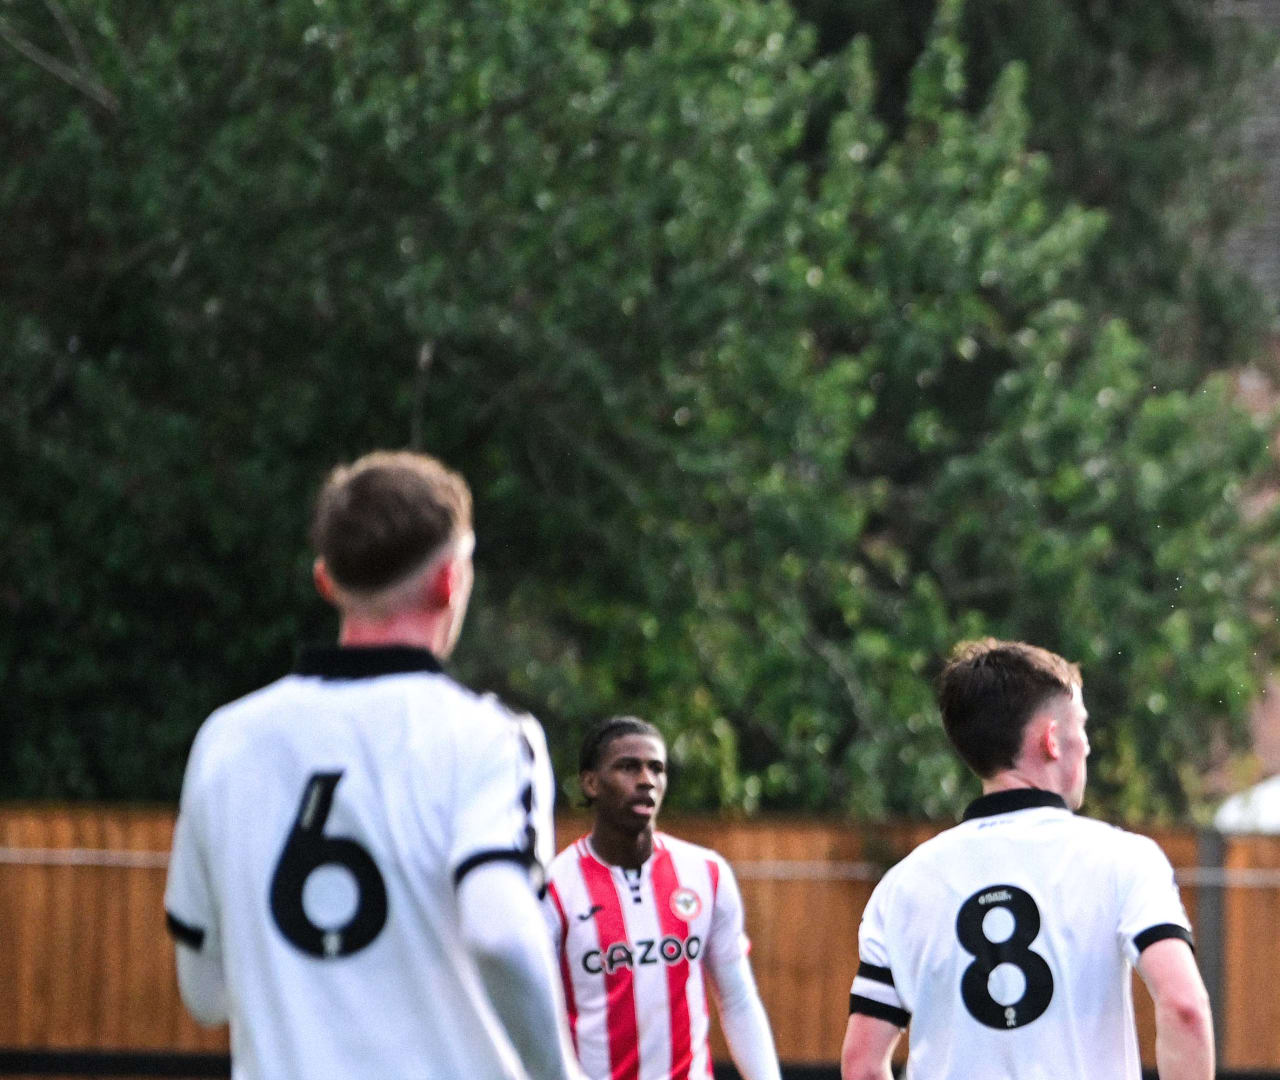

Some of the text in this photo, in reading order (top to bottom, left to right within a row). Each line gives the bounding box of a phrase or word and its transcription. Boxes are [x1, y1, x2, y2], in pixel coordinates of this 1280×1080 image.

[269, 769, 390, 961] 6
[582, 936, 701, 975] CAZOO
[957, 884, 1054, 1031] 8
